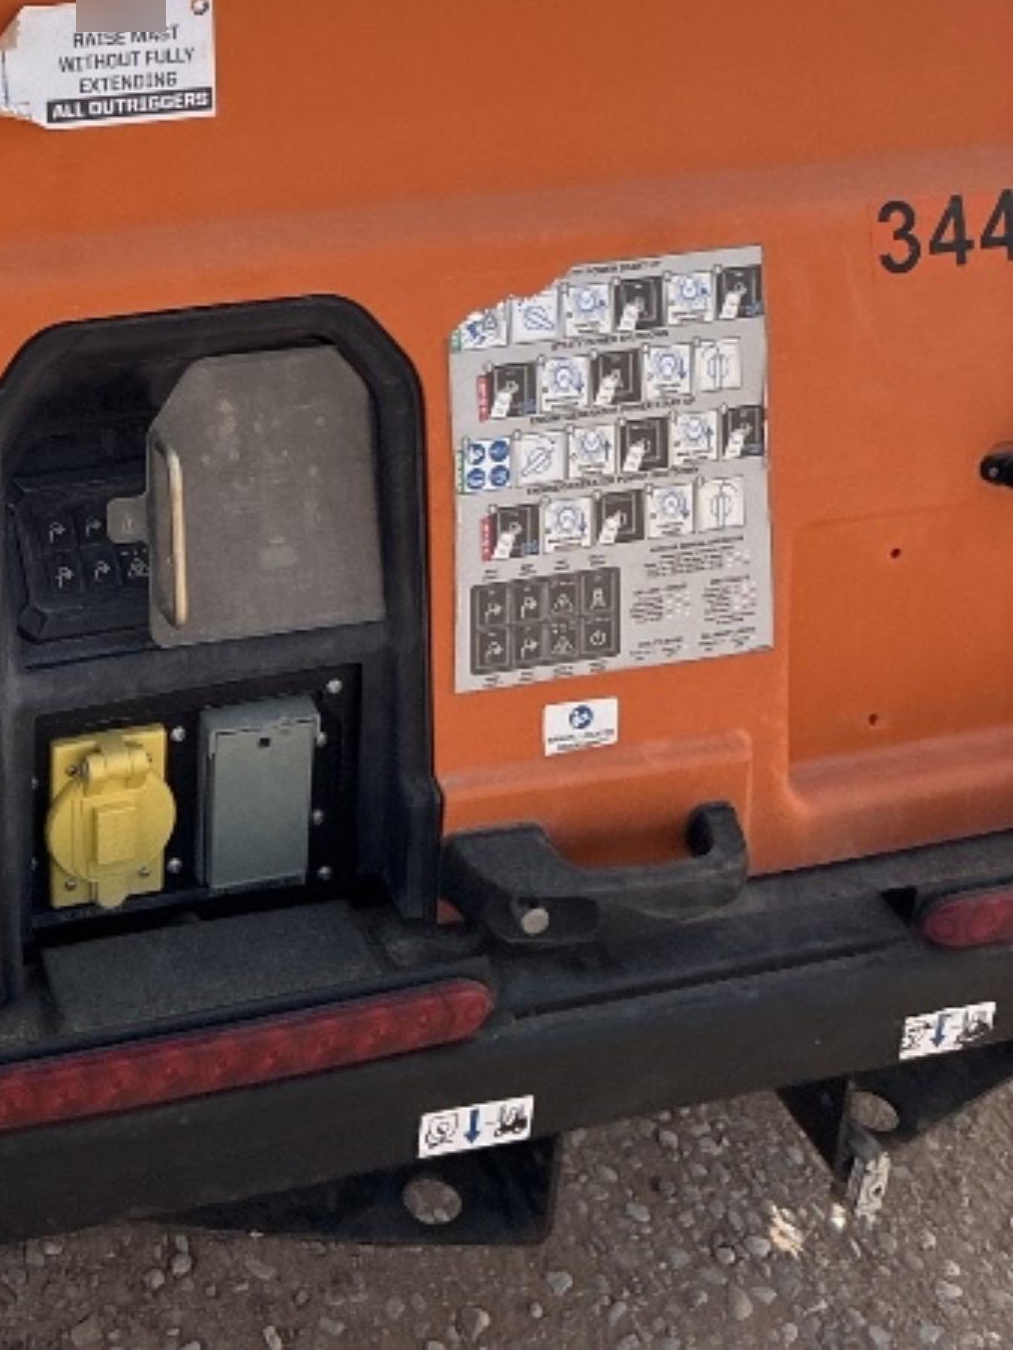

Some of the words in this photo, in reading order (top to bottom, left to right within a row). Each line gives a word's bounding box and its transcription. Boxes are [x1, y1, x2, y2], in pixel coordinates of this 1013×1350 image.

[73, 30, 126, 49] RAISE
[58, 50, 141, 73] WITHOUT
[145, 46, 194, 66] FULLY
[79, 72, 176, 94] EXTENDING
[51, 103, 87, 121] ALL
[90, 91, 209, 116] OUTRIGGERS
[877, 188, 1013, 274] 344
